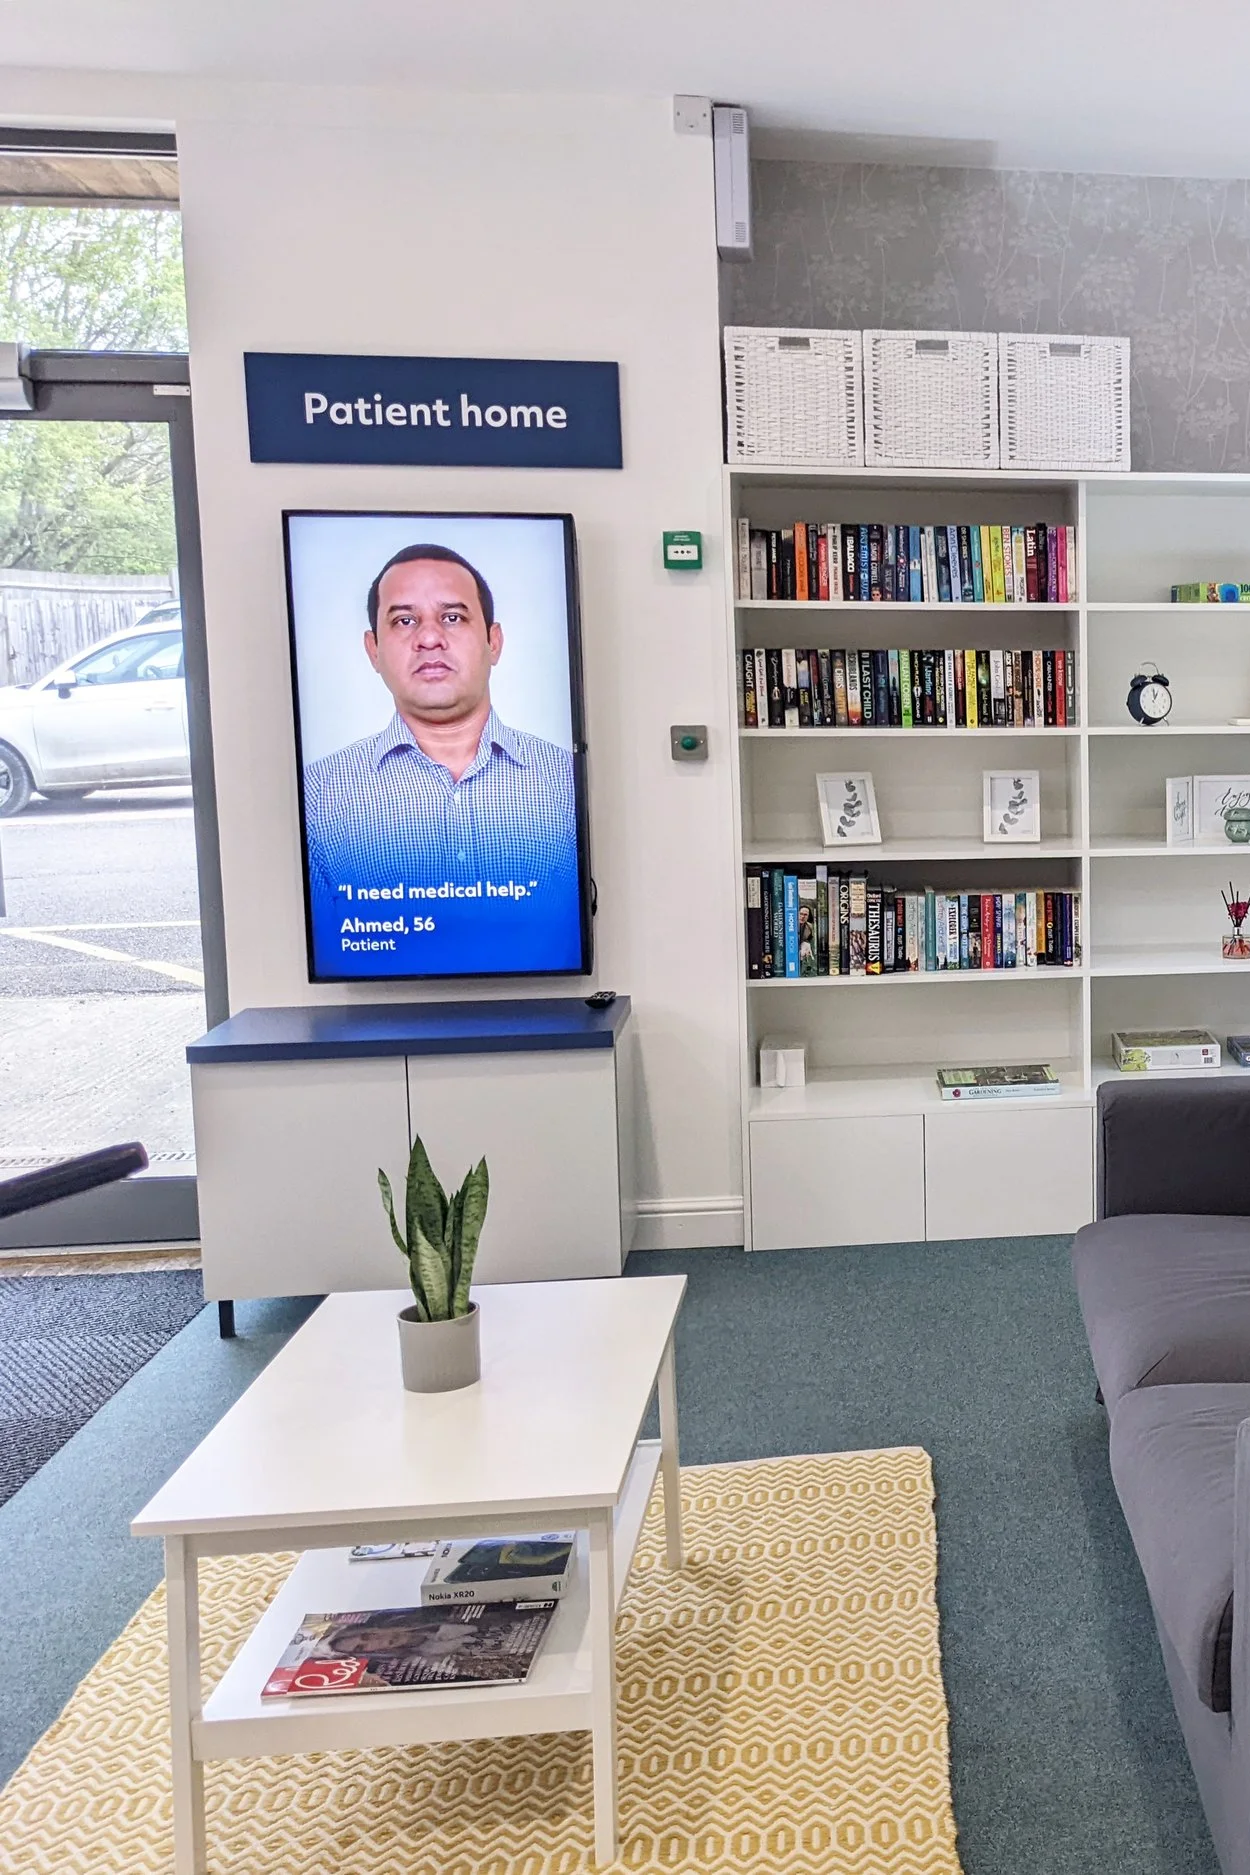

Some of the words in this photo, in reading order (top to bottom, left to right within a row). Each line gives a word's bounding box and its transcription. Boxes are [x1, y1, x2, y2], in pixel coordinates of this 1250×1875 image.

[304, 392, 452, 426] Patient
[459, 393, 568, 429] home
[860, 527, 869, 568] ARTEMIS
[949, 527, 957, 545] Ann
[1002, 528, 1010, 544] BEN
[1026, 529, 1036, 557] Latin
[870, 542, 878, 562] SIMON
[951, 545, 960, 579] Cleeves
[1003, 545, 1013, 577] STOKES
[871, 562, 879, 584] COWELL
[745, 653, 754, 689] CAUGHT
[834, 668, 844, 688] CHRIS
[862, 664, 872, 691] LAST
[901, 651, 910, 682] HARLAN
[863, 691, 873, 719] CHILD
[903, 682, 911, 709] COBEN
[357, 883, 404, 901] need
[408, 881, 482, 899] medical
[486, 880, 539, 901] help.”
[840, 885, 849, 925] ORIGINS
[340, 916, 410, 935] Ahmed,
[413, 916, 436, 932] 56
[867, 903, 881, 962] THESAURUS
[341, 938, 397, 952] Patient
[968, 1088, 1002, 1096] GARDENING
[428, 1592, 452, 1601] Nokia
[453, 1590, 476, 1599] XR20
[294, 1656, 361, 1690] Red
